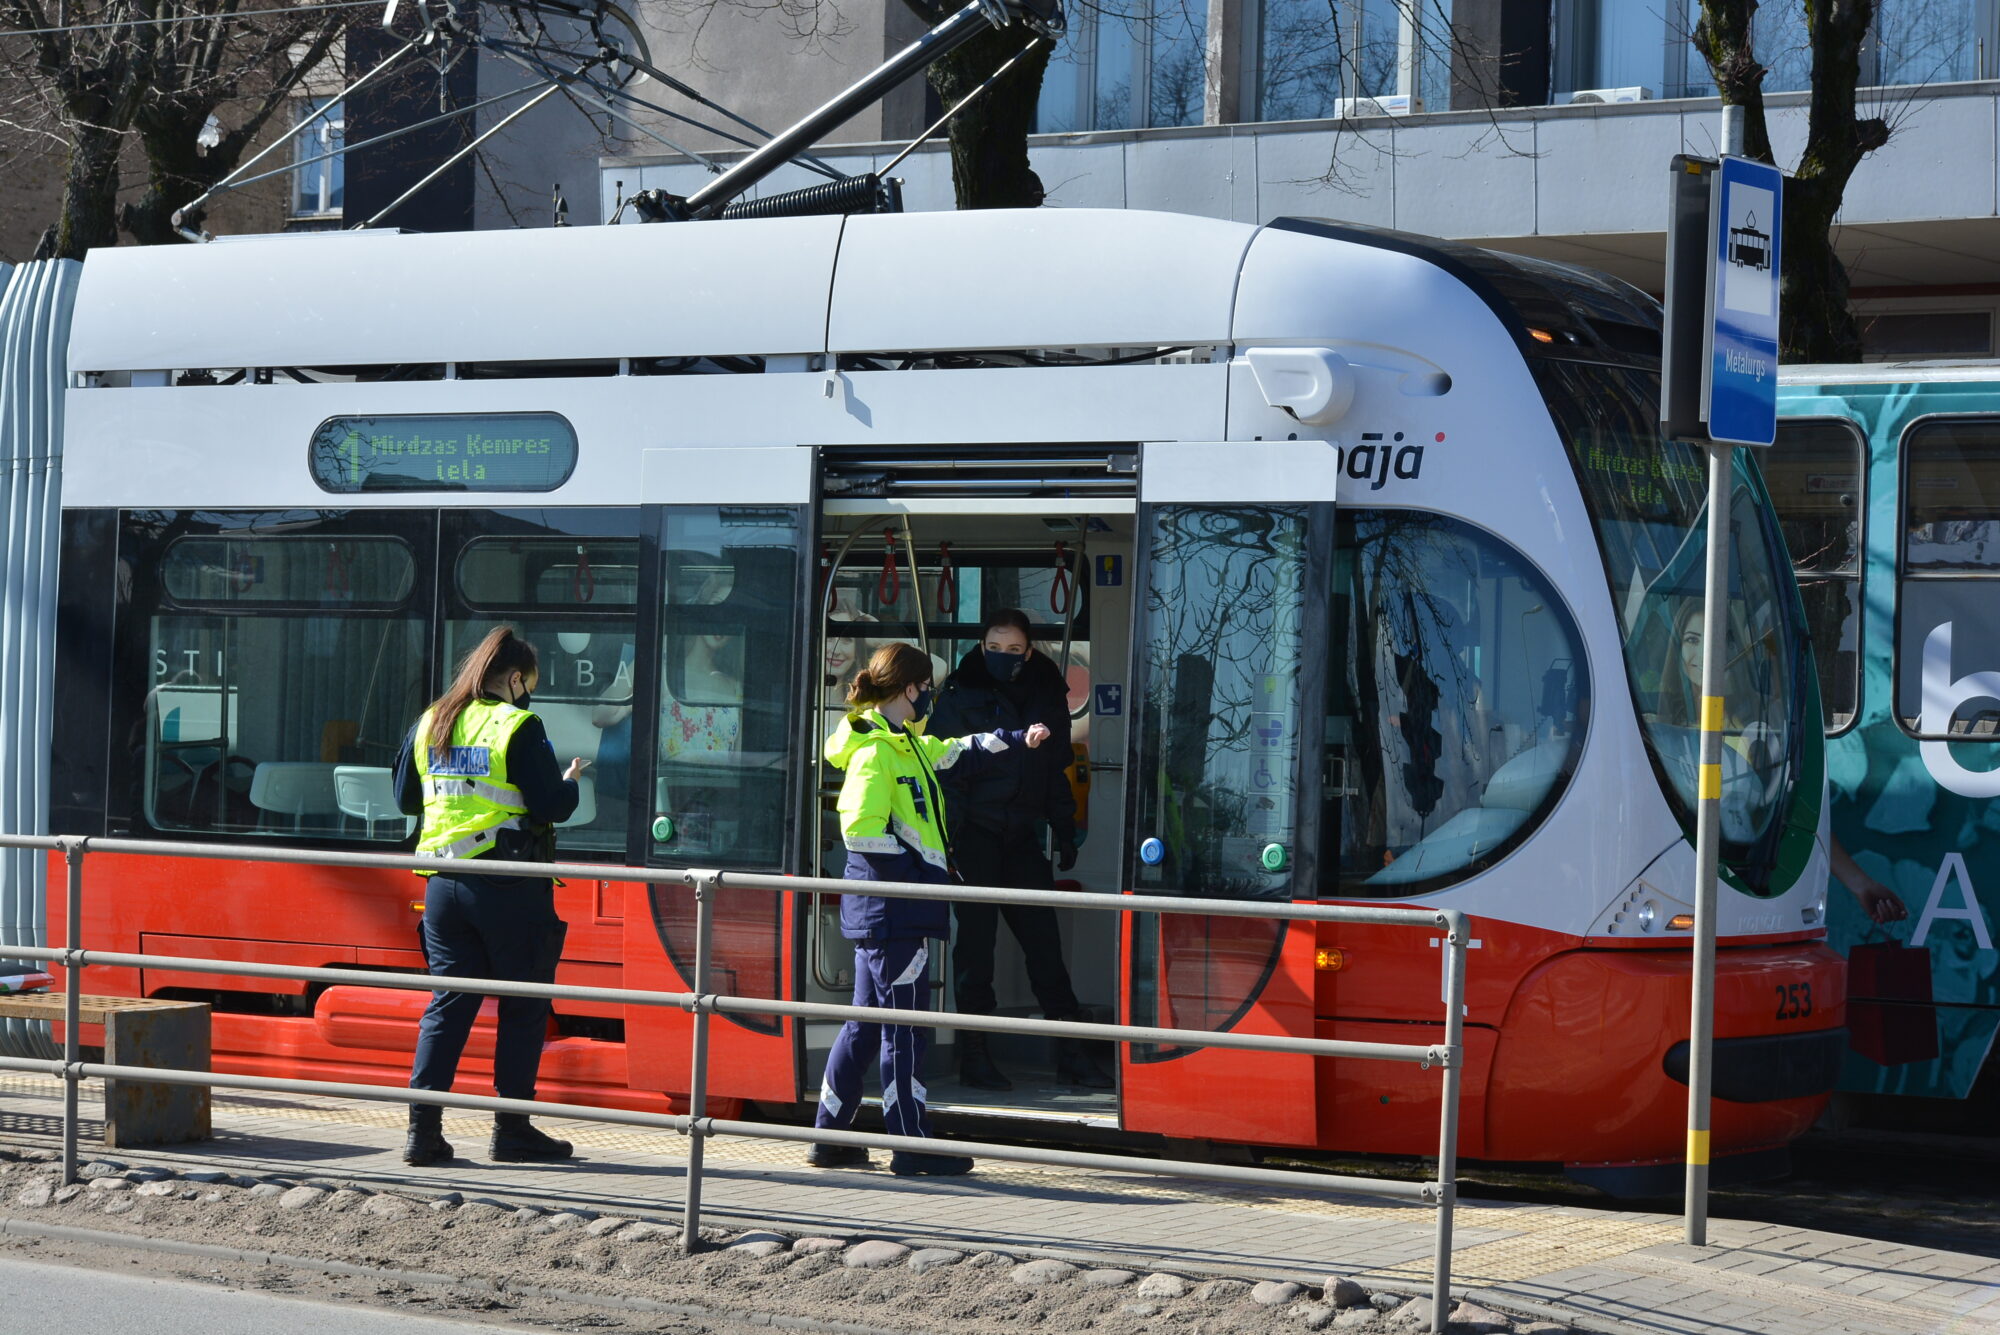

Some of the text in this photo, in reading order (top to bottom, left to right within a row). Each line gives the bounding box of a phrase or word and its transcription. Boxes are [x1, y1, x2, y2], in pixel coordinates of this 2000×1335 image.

[1726, 348, 1766, 383] Metalurgs
[338, 430, 359, 484] 1
[371, 435, 457, 456] Mirdzas
[436, 459, 486, 481] iela
[1588, 448, 1647, 476] Mirdzas
[1631, 479, 1663, 505] iela
[1776, 982, 1812, 1020] 253
